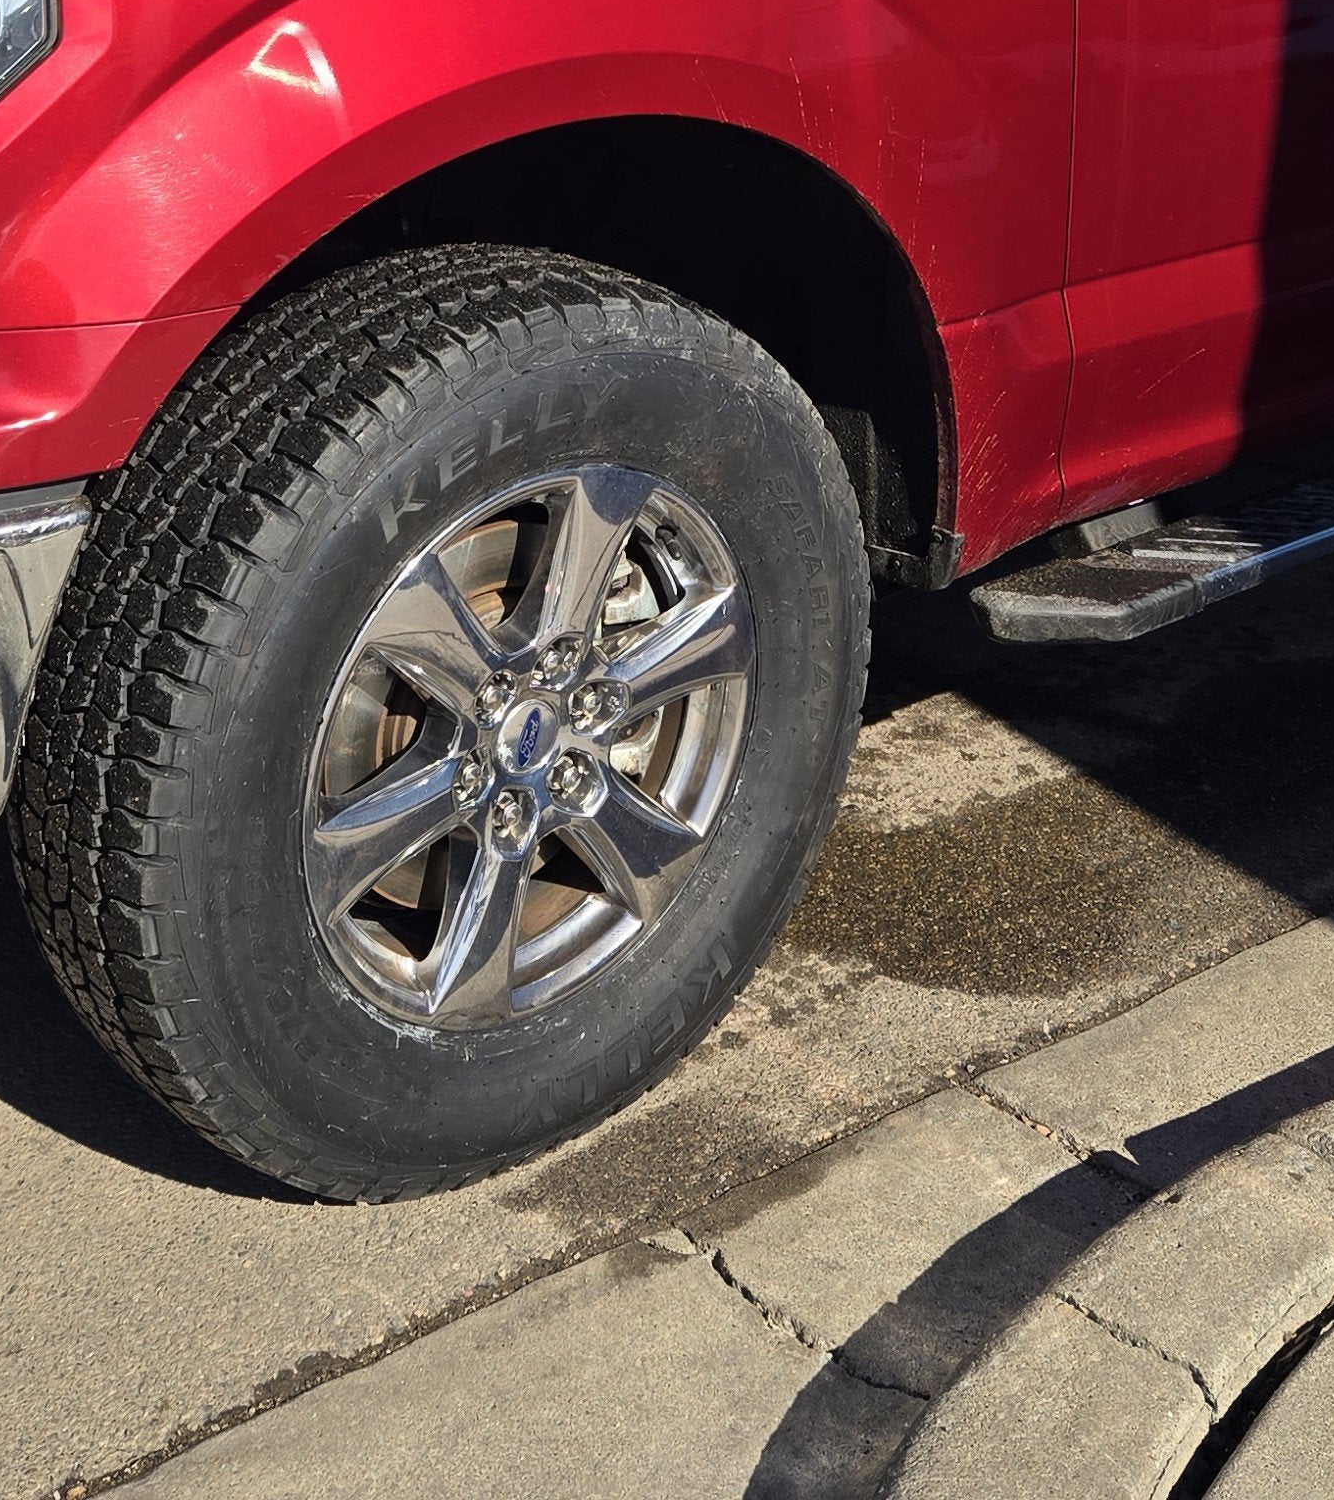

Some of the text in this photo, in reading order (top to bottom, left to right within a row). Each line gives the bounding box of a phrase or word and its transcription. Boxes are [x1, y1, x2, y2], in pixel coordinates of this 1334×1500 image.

[378, 377, 619, 544] KELLY
[764, 474, 831, 631] SAFARI
[520, 719, 539, 759] Ford
[509, 939, 733, 1136] KELLY
